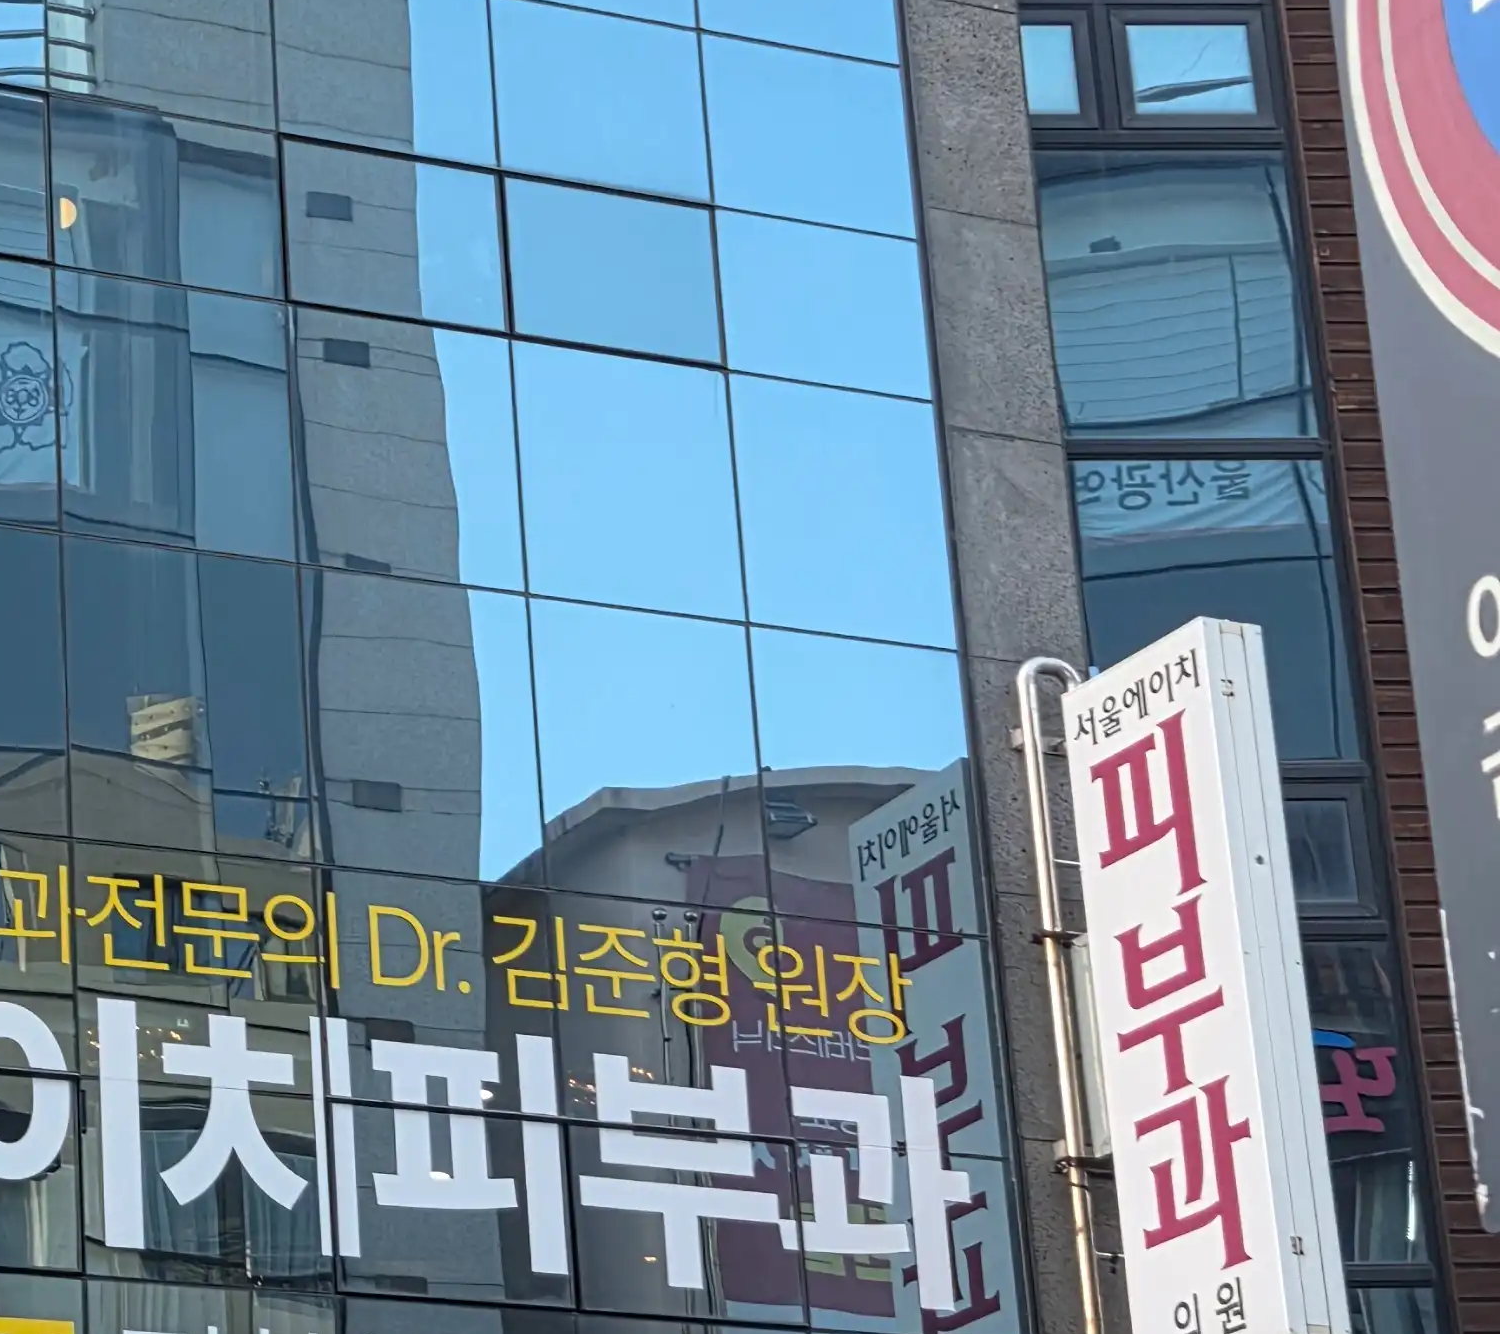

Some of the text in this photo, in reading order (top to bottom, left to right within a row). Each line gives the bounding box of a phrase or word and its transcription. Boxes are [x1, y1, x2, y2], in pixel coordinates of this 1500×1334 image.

[1073, 648, 1201, 746] 서울에이치
[369, 904, 471, 995] Dr.
[492, 913, 732, 1028] 김준형
[752, 944, 913, 1046] 원장
[1090, 708, 1253, 1271] 피부과
